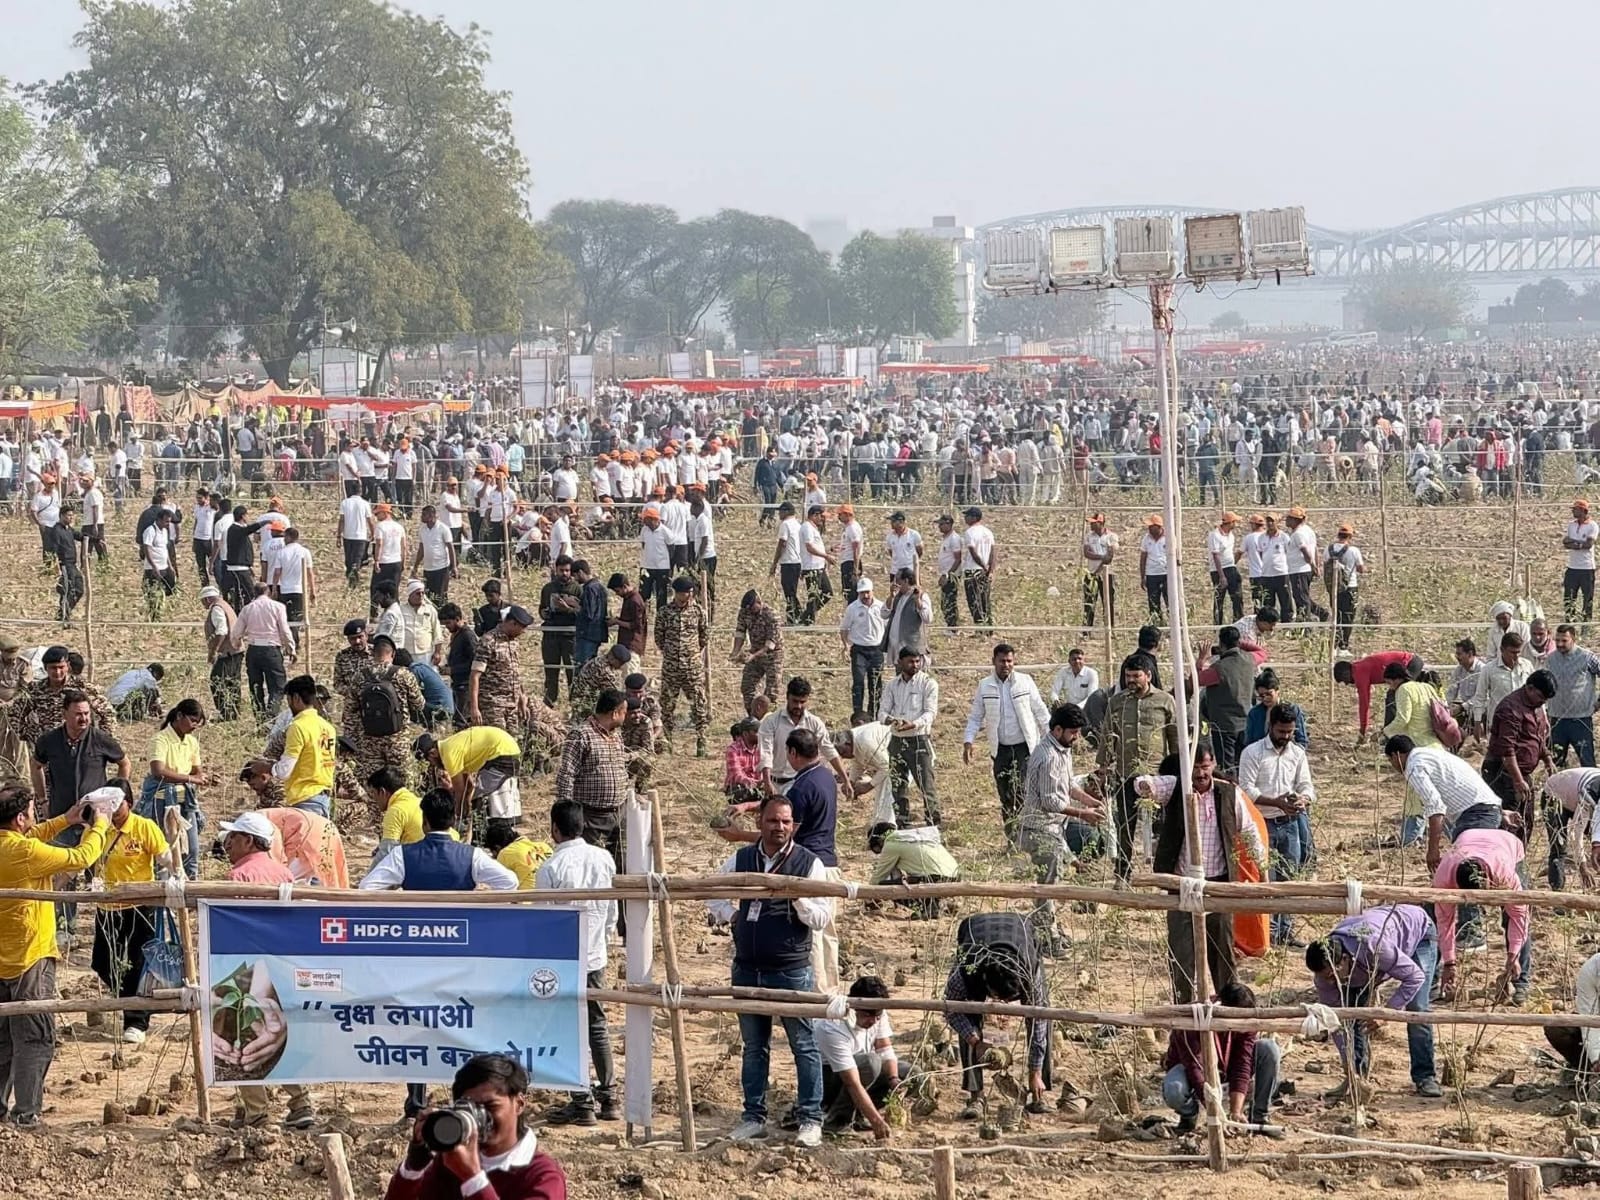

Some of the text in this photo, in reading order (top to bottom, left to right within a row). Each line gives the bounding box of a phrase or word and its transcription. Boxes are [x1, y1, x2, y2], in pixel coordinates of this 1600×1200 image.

[353, 924, 459, 939] HDFC BANK
[330, 1003, 376, 1033] वृक्ष
[382, 996, 475, 1030] लगाओ
[354, 1035, 429, 1067] जीवन
